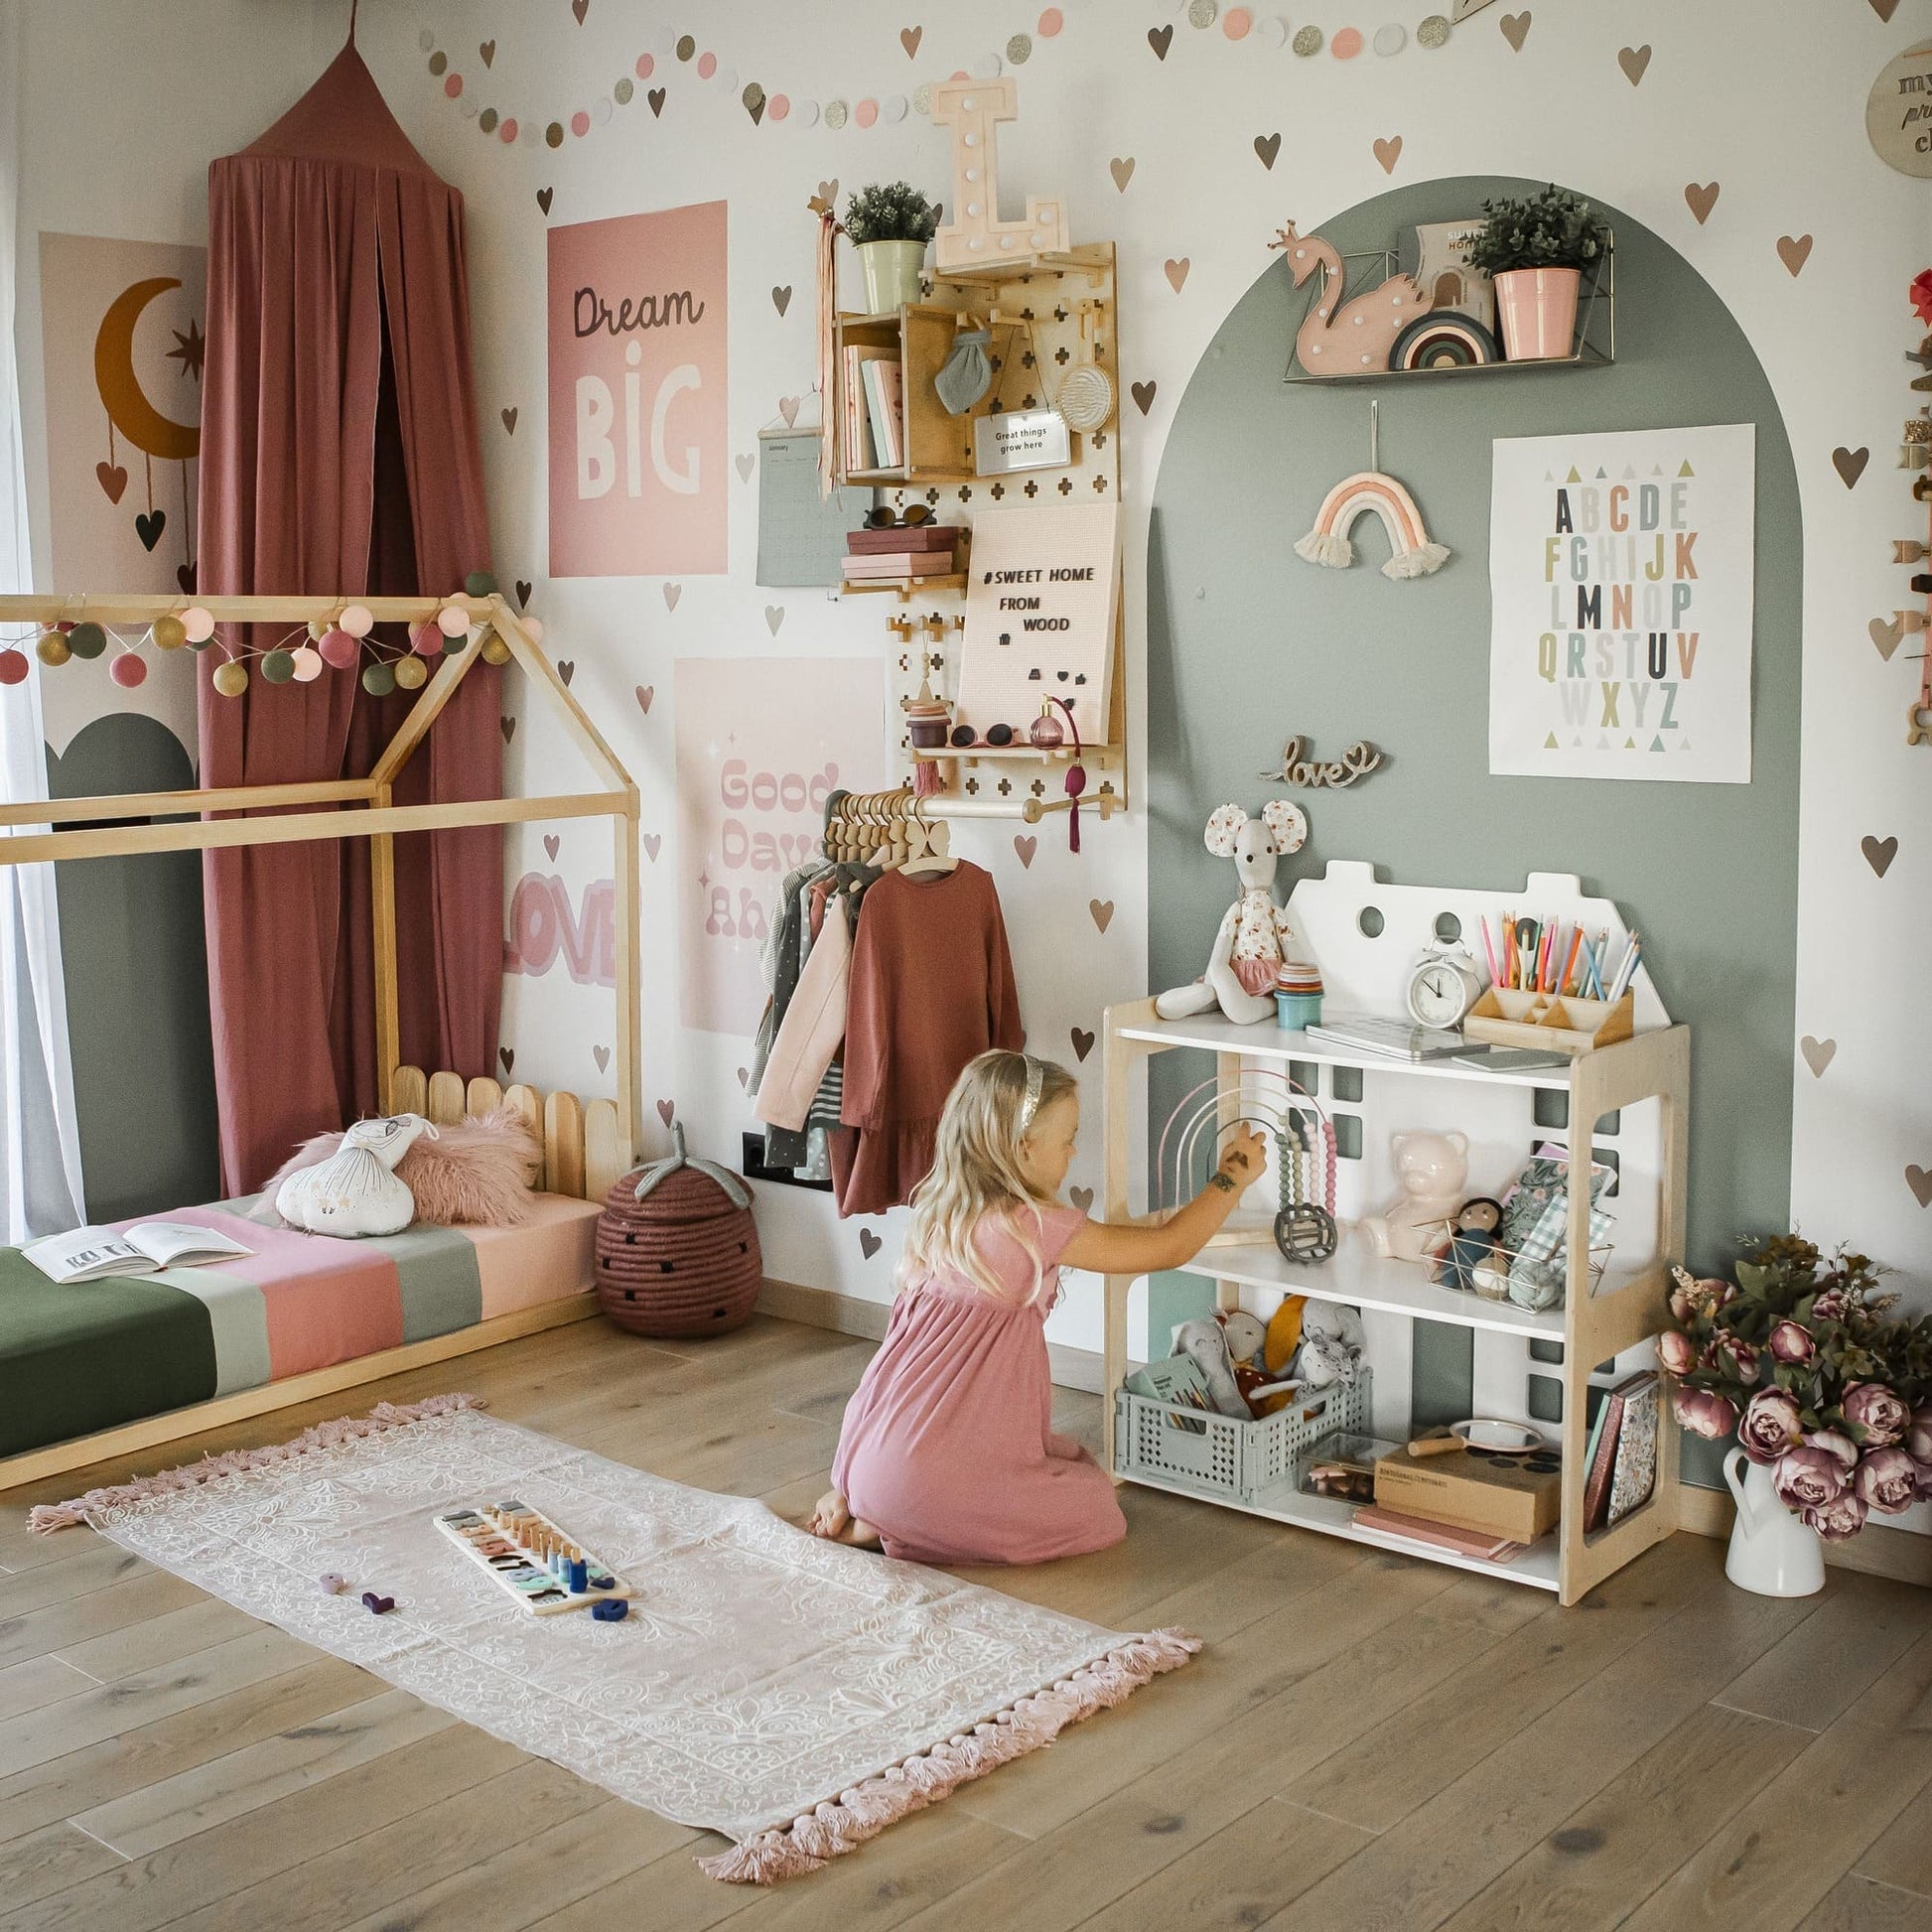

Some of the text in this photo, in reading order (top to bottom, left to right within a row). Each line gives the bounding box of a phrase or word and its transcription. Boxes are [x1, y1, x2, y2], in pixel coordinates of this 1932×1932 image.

[1449, 241, 1472, 250] HOM
[574, 287, 705, 338] Dream
[995, 428, 1047, 441] Great things
[1000, 445, 1023, 455] grow
[983, 568, 1096, 584] #SWEET HOME
[999, 597, 1040, 611] FROM
[1023, 618, 1070, 631] WOOD
[1258, 735, 1384, 788] love
[722, 759, 839, 813] Good
[722, 818, 823, 872] Day
